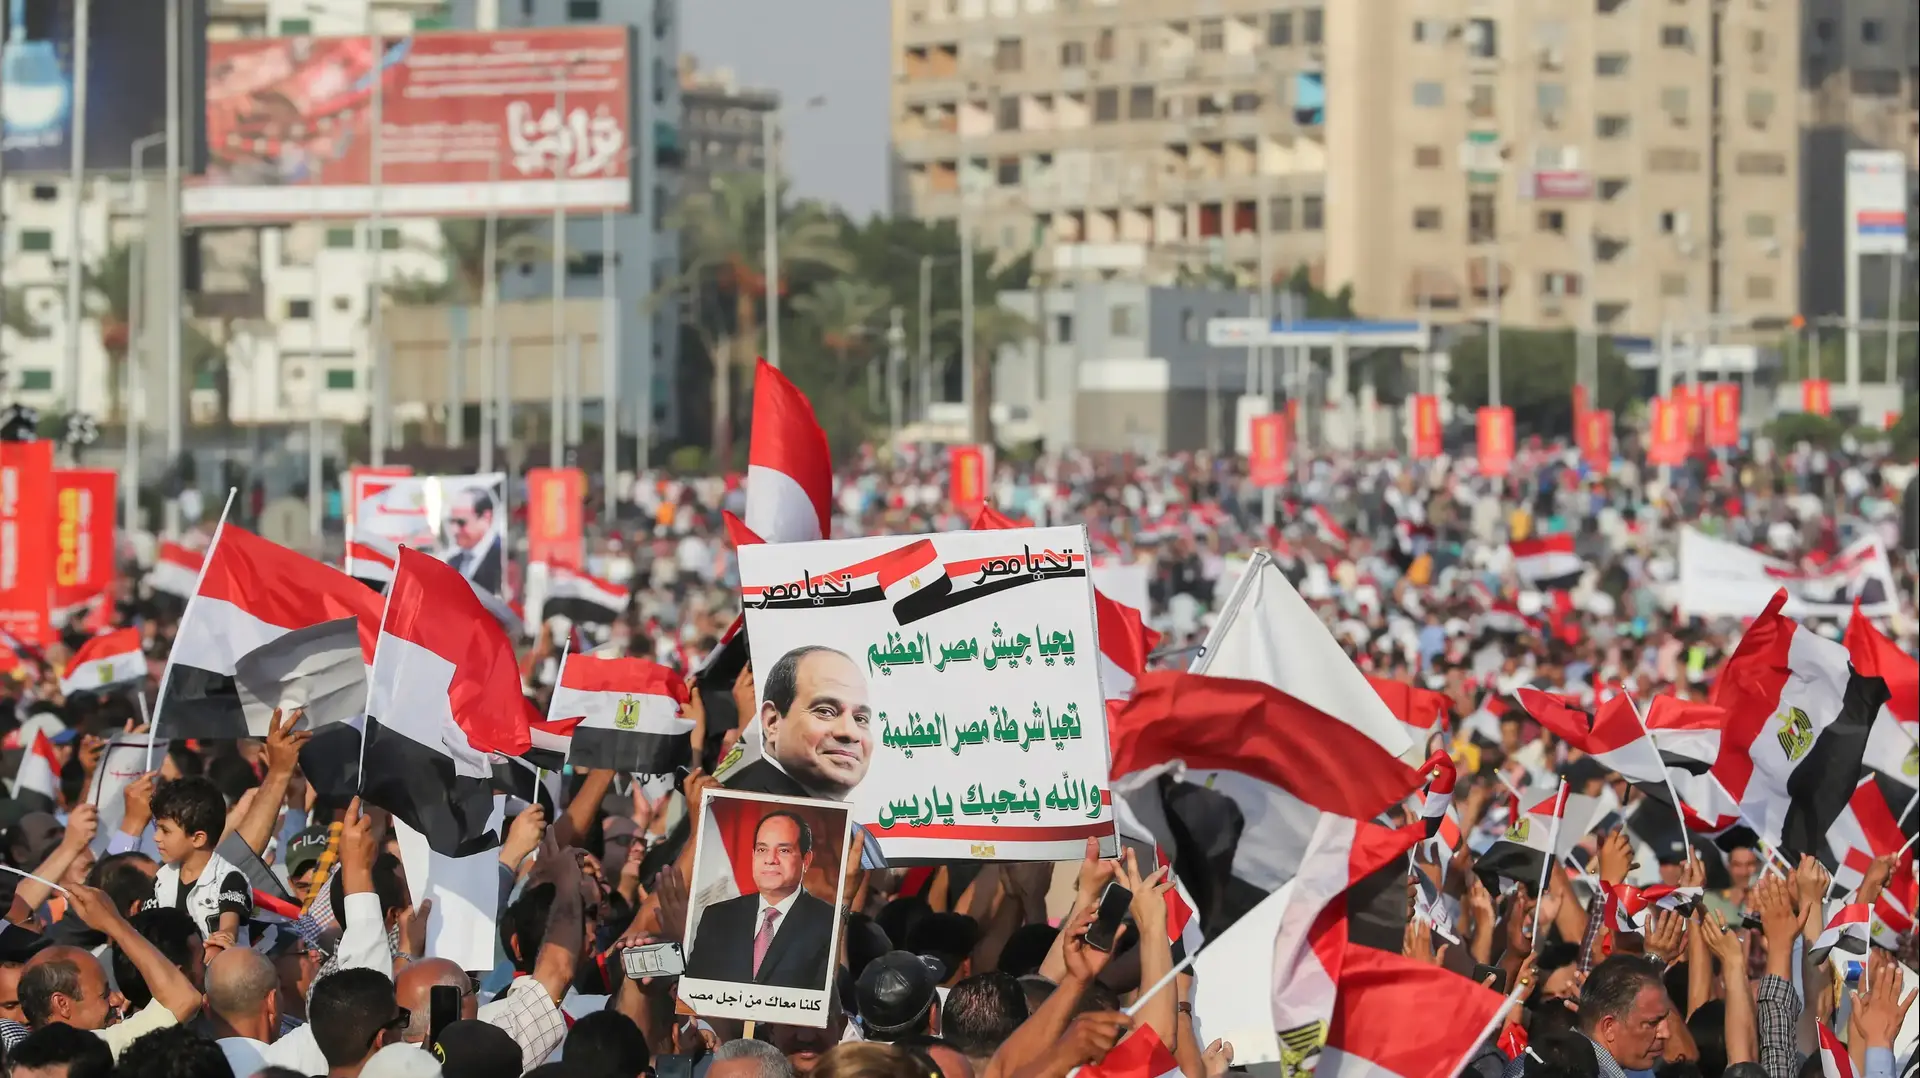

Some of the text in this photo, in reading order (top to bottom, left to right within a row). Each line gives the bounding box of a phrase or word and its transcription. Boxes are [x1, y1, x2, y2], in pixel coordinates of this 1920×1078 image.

[973, 544, 1073, 585] تحيا مصر
[752, 569, 852, 610] تحيا مصر
[867, 621, 1075, 678] يحيا جيش مصر العظيم
[878, 701, 1082, 758] تحيا شرطة مصر العظيمة
[960, 778, 1041, 824] بنحبك
[1045, 772, 1102, 818] والله
[292, 834, 326, 852] FILA
[716, 990, 743, 1006] أجل
[744, 994, 762, 1008] من
[764, 995, 797, 1008] معاك
[799, 998, 822, 1011] كلنا
